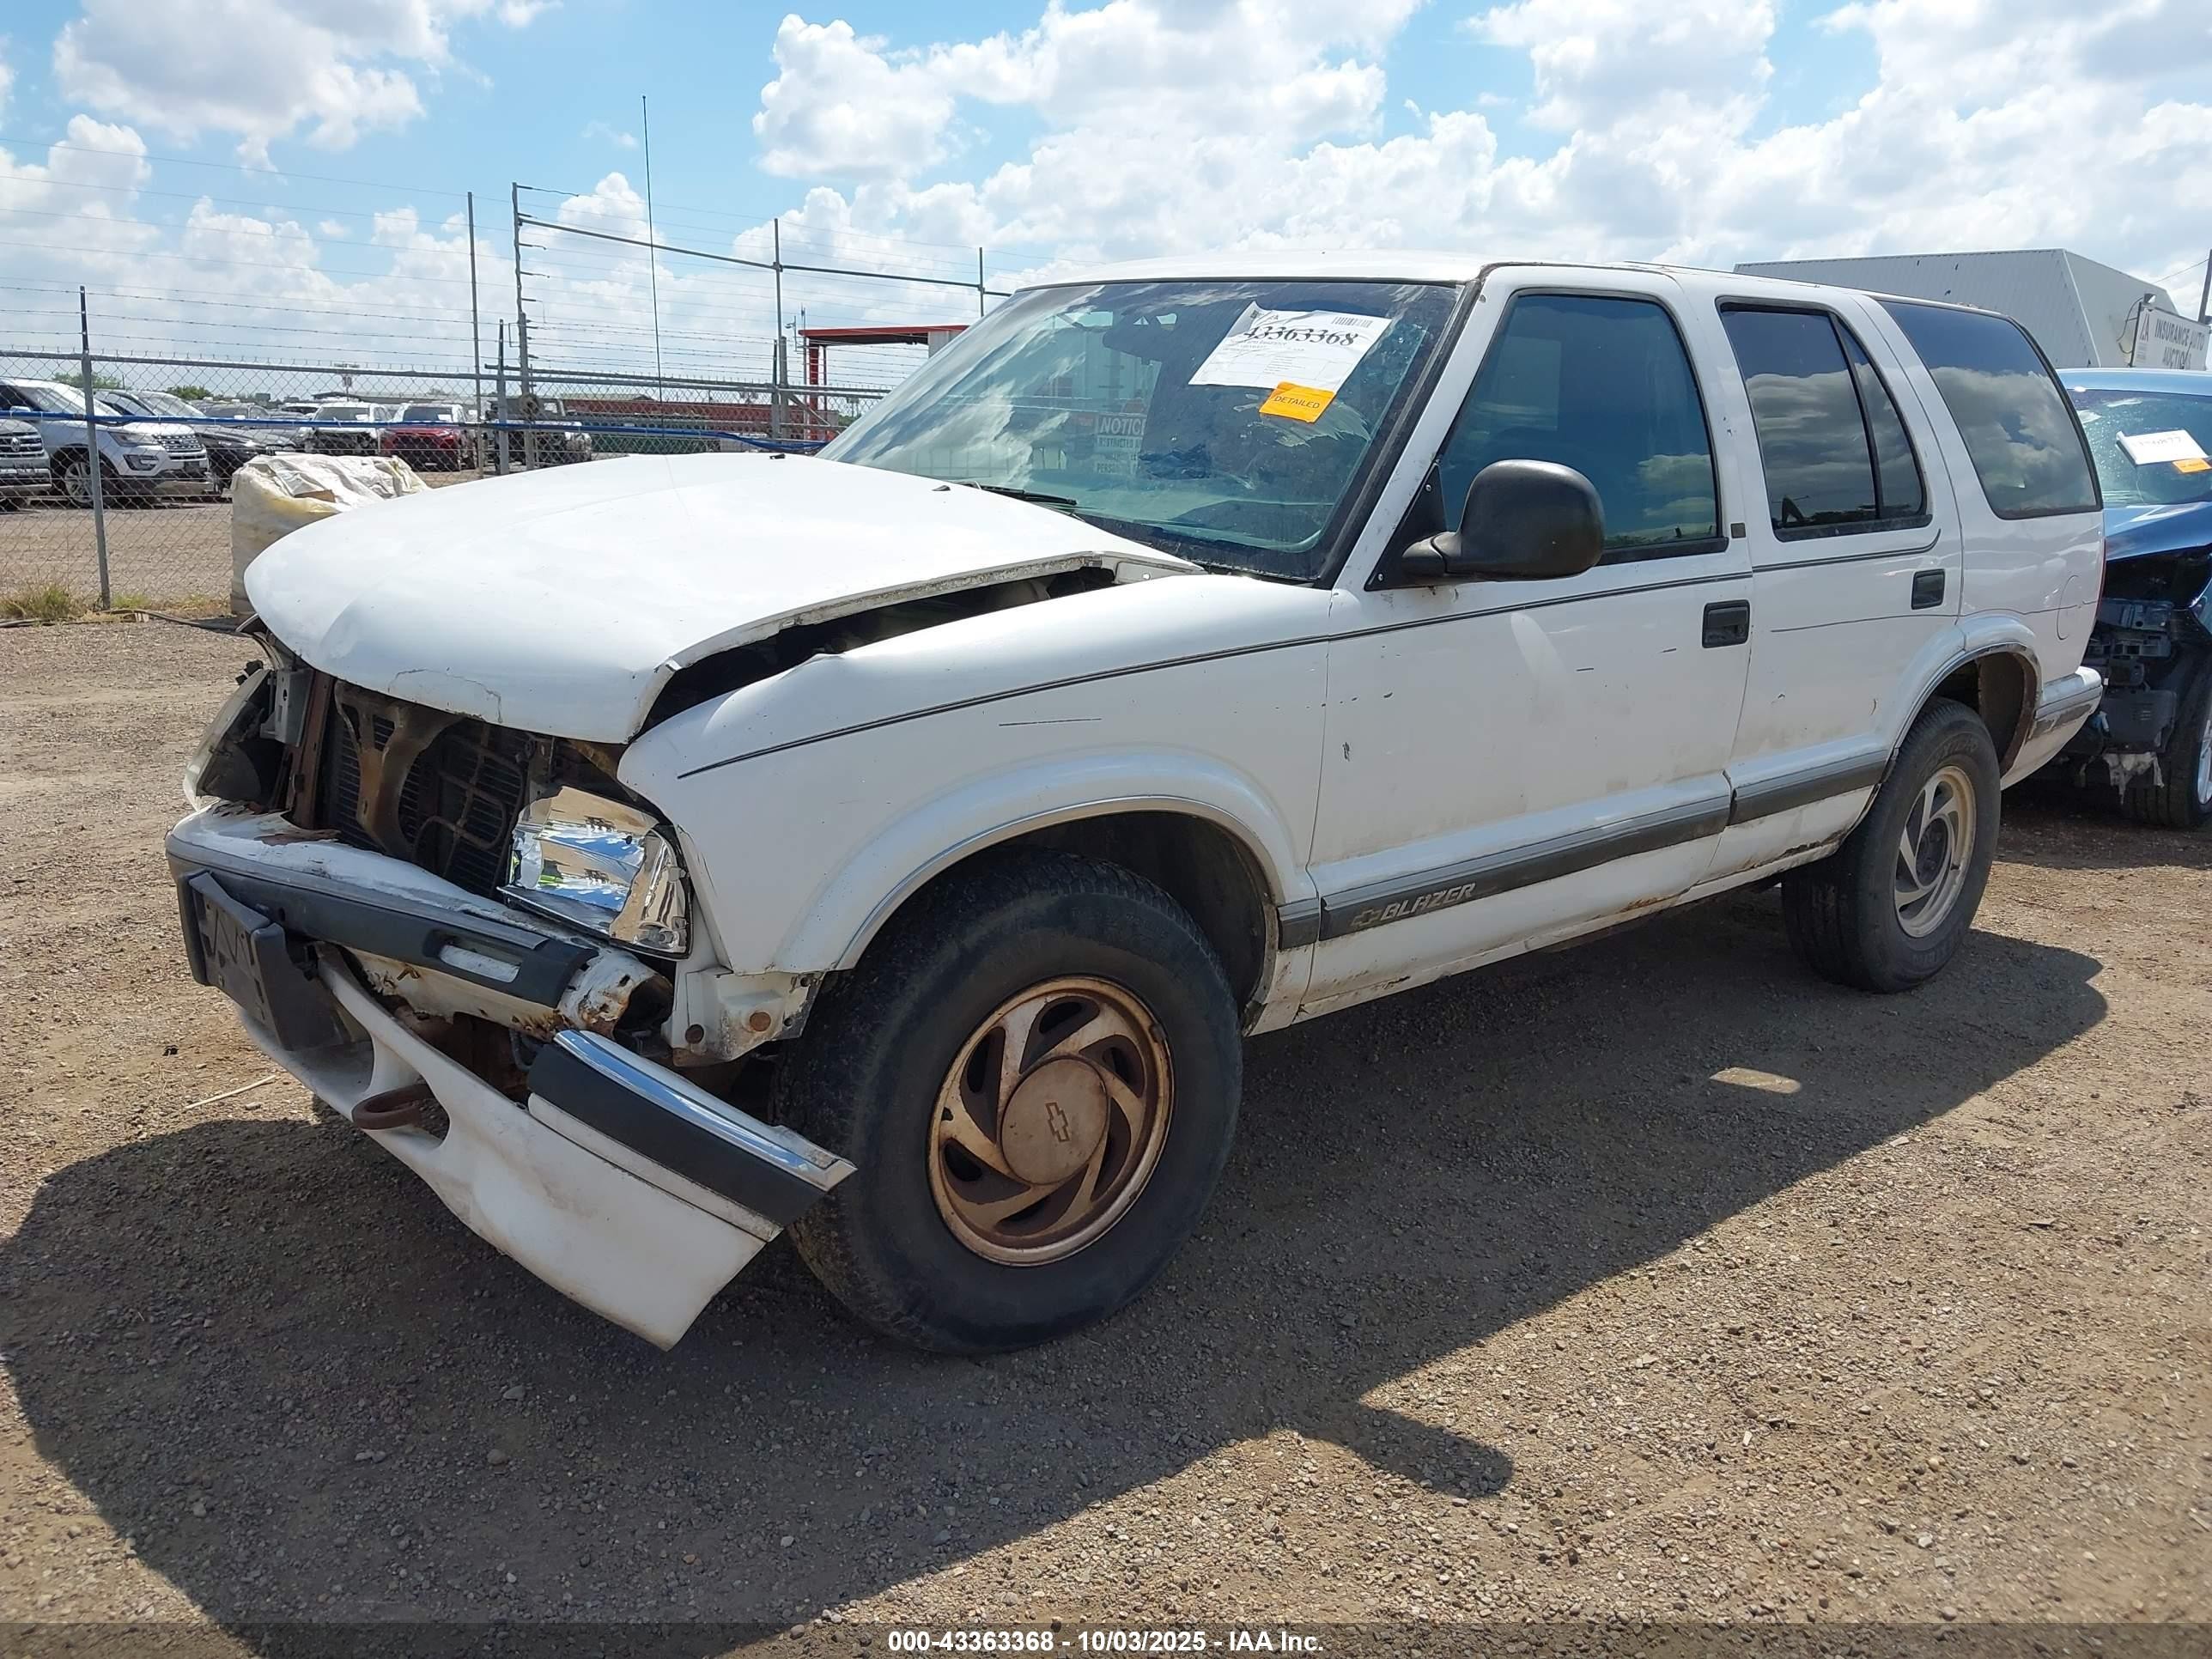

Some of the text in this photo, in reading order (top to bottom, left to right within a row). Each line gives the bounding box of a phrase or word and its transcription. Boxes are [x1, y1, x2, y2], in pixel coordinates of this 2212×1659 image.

[1243, 325, 1358, 346] 43363368
[2154, 319, 2190, 346] INSURANCE
[1273, 394, 1320, 409] DETAILED
[1380, 883, 1477, 922] BLAZER
